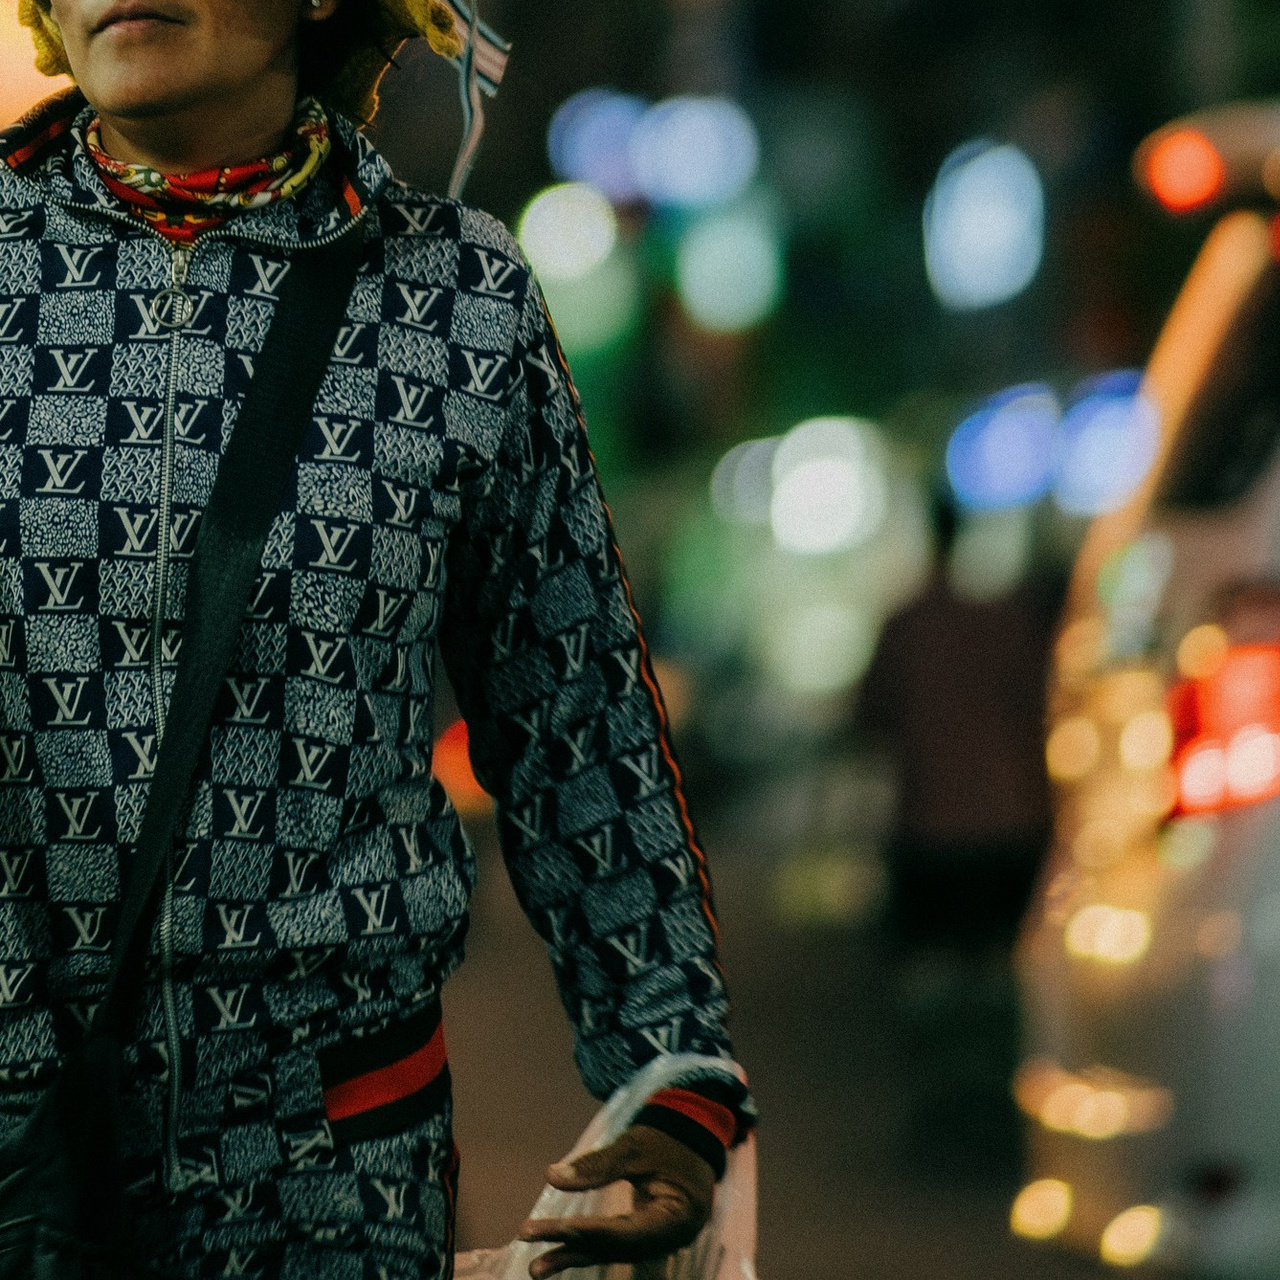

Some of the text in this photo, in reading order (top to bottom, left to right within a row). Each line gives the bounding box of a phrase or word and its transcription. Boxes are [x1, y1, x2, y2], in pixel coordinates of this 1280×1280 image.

[391, 204, 444, 235] LV
[54, 244, 103, 287] LV
[244, 254, 291, 301] LV
[470, 248, 517, 300] LV
[395, 282, 443, 332] LV
[47, 349, 98, 391] LV
[461, 349, 507, 402] LV
[120, 401, 164, 444] LV
[388, 375, 433, 428] LV
[313, 417, 361, 462] LV
[35, 450, 88, 493] LV
[382, 480, 419, 528] LV
[114, 507, 158, 556] LV
[310, 520, 359, 571] LV
[34, 562, 84, 610] LV
[362, 589, 407, 637] LV
[112, 621, 150, 666] LV
[300, 631, 346, 684] LV
[42, 677, 91, 725] LV
[225, 678, 270, 724] LV
[289, 737, 336, 790] LV
[619, 743, 669, 800] LV
[56, 792, 102, 839] LV
[223, 789, 266, 838] LV
[279, 852, 319, 898] LV
[63, 907, 112, 951] LV
[217, 905, 262, 948] LV
[351, 884, 397, 935] LV
[606, 922, 663, 976] LV
[206, 984, 257, 1032] LV
